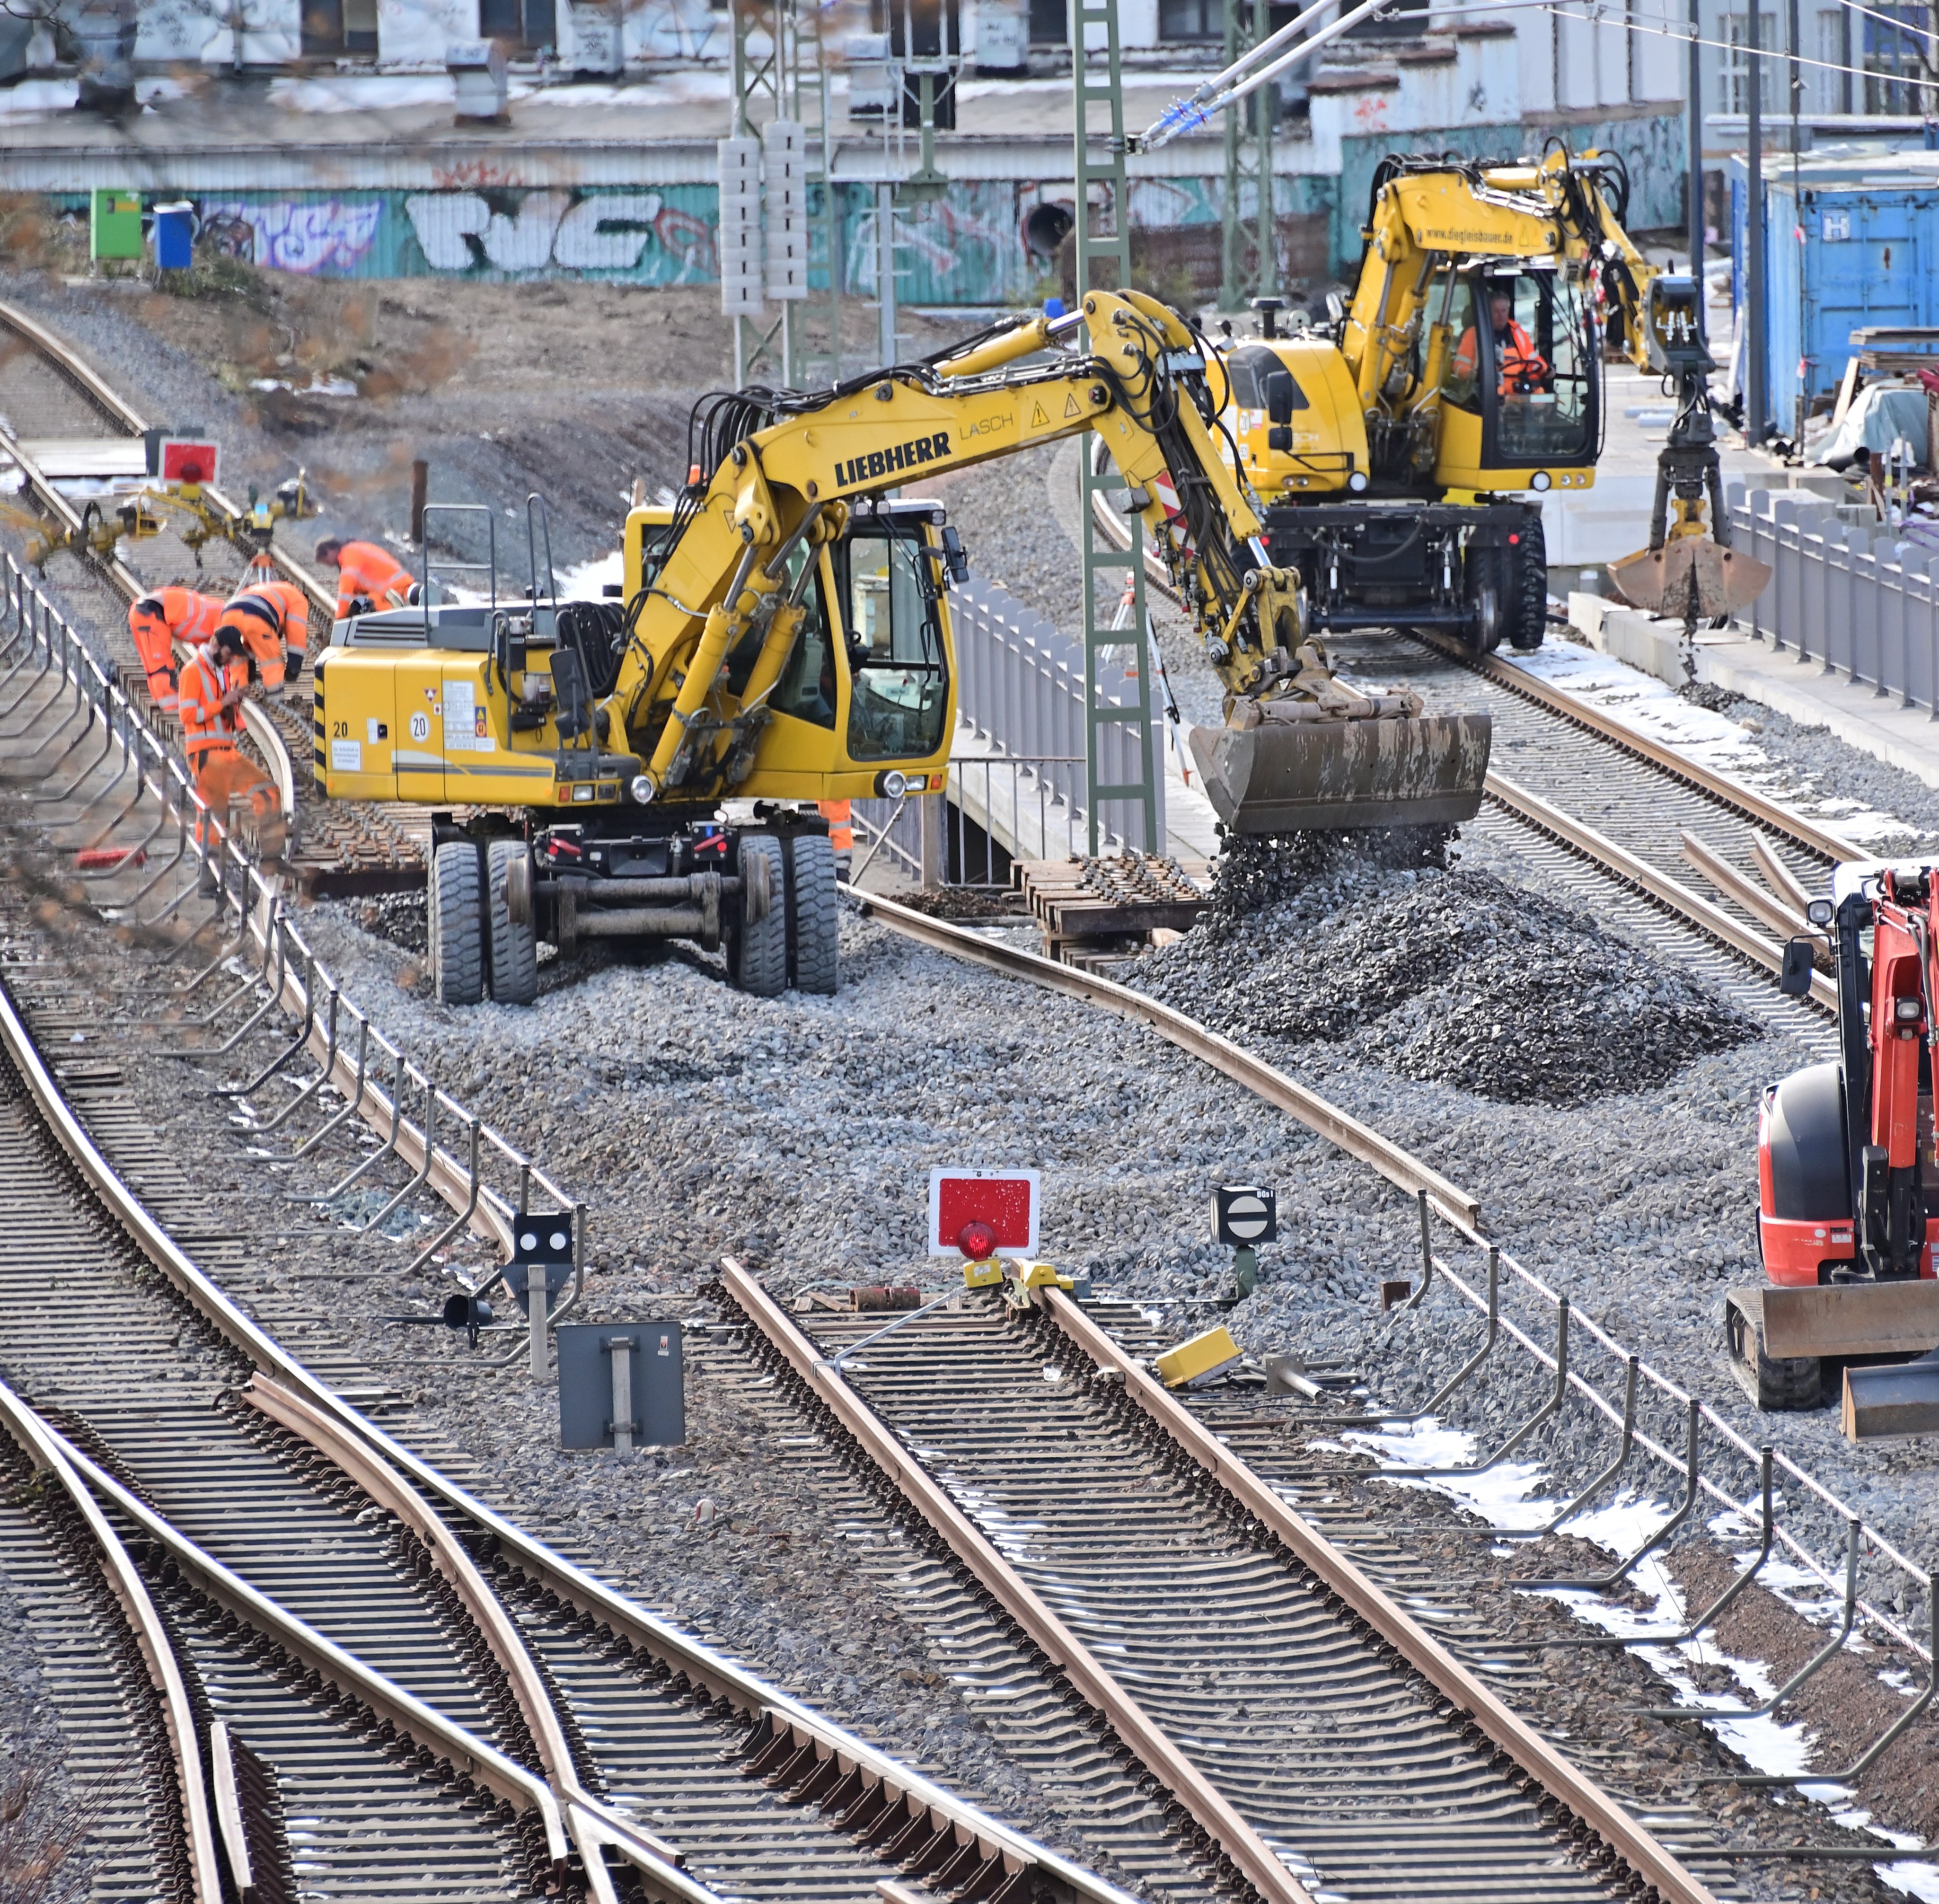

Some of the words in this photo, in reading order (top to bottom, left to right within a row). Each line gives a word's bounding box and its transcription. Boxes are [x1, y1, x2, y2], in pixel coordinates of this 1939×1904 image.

[959, 413, 1014, 441] LASCH
[835, 432, 952, 488] LIEBHERR
[334, 722, 348, 738] 20
[414, 717, 426, 737] 20
[1257, 1190, 1269, 1198] BGs
